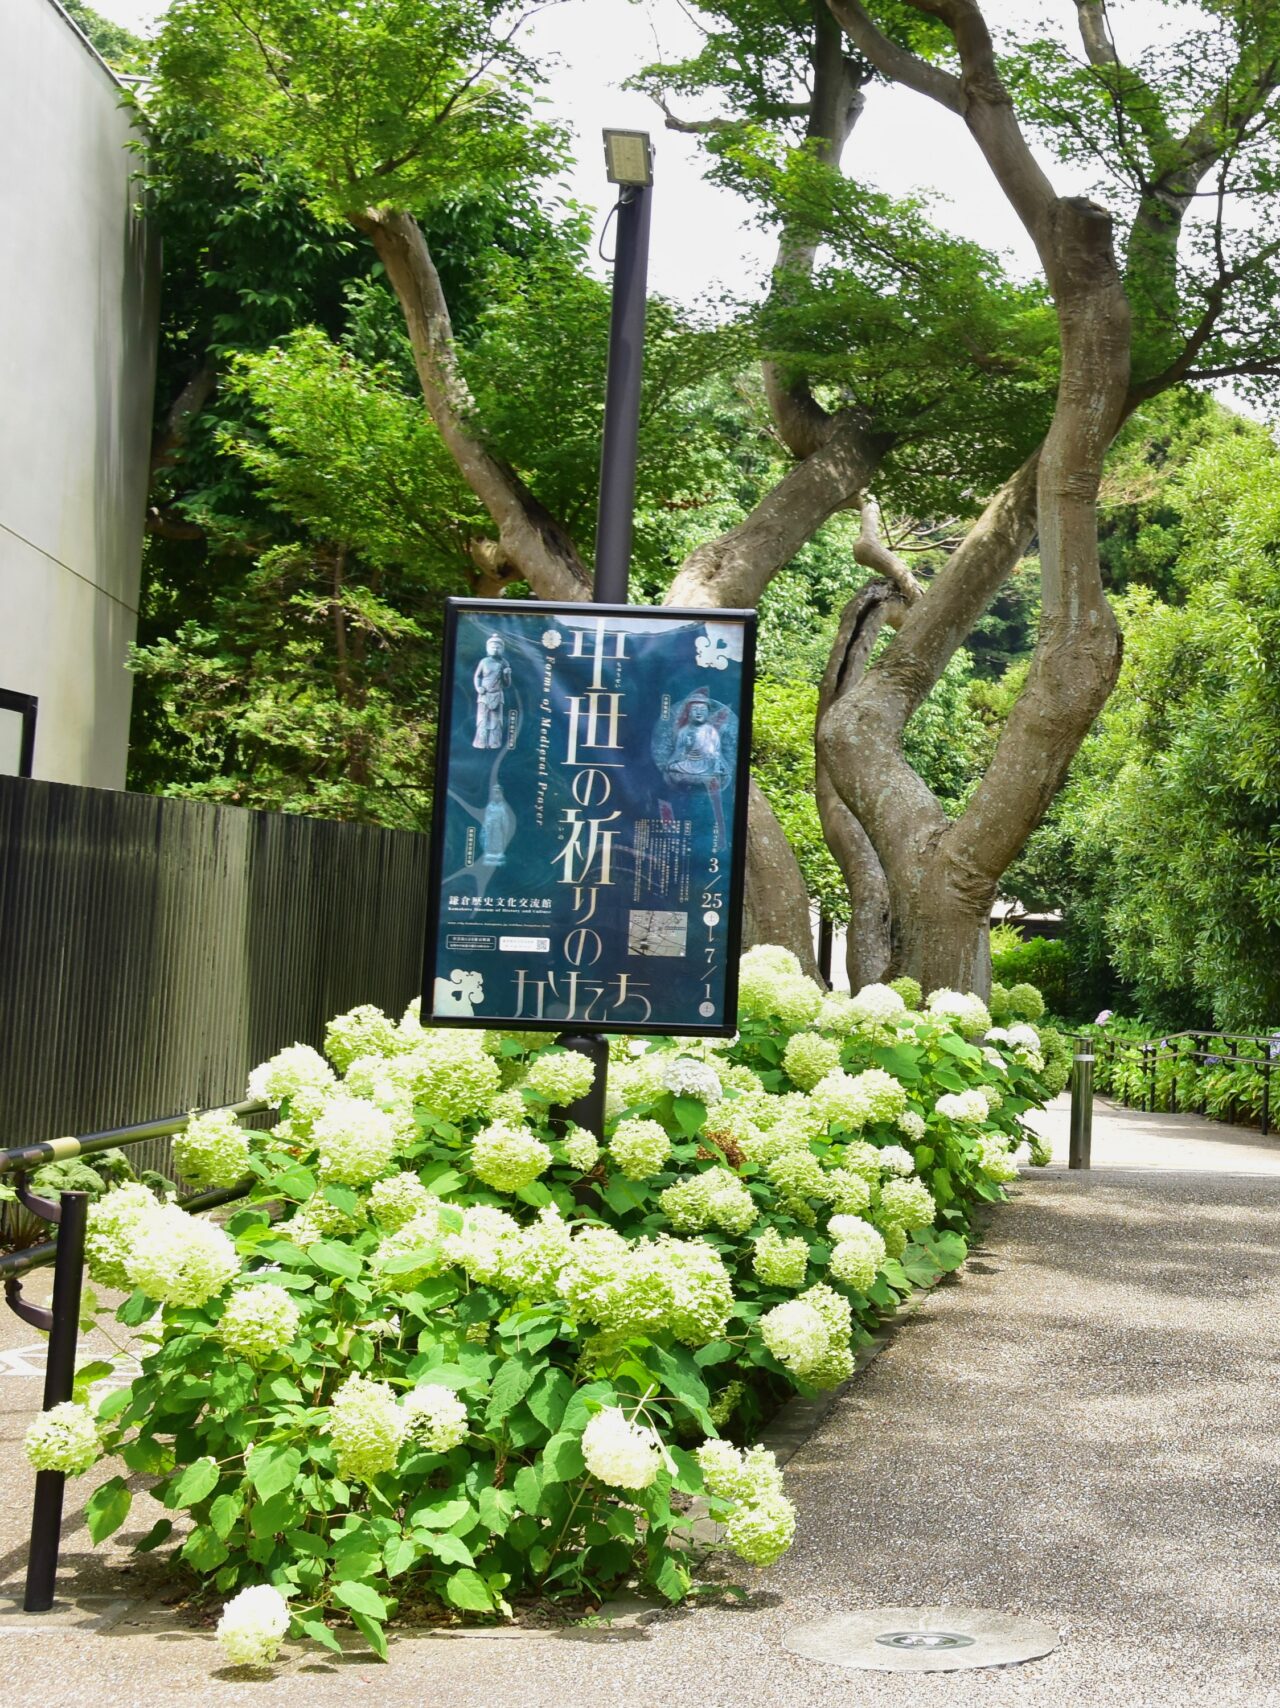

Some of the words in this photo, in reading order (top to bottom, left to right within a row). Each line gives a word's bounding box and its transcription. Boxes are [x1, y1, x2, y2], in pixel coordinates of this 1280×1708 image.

[543, 655, 556, 693] Forms
[540, 698, 552, 713] of
[534, 781, 549, 827] Prayer
[448, 895, 553, 909] 鎌倉歴史文化交流館
[510, 969, 652, 1023] かたち
